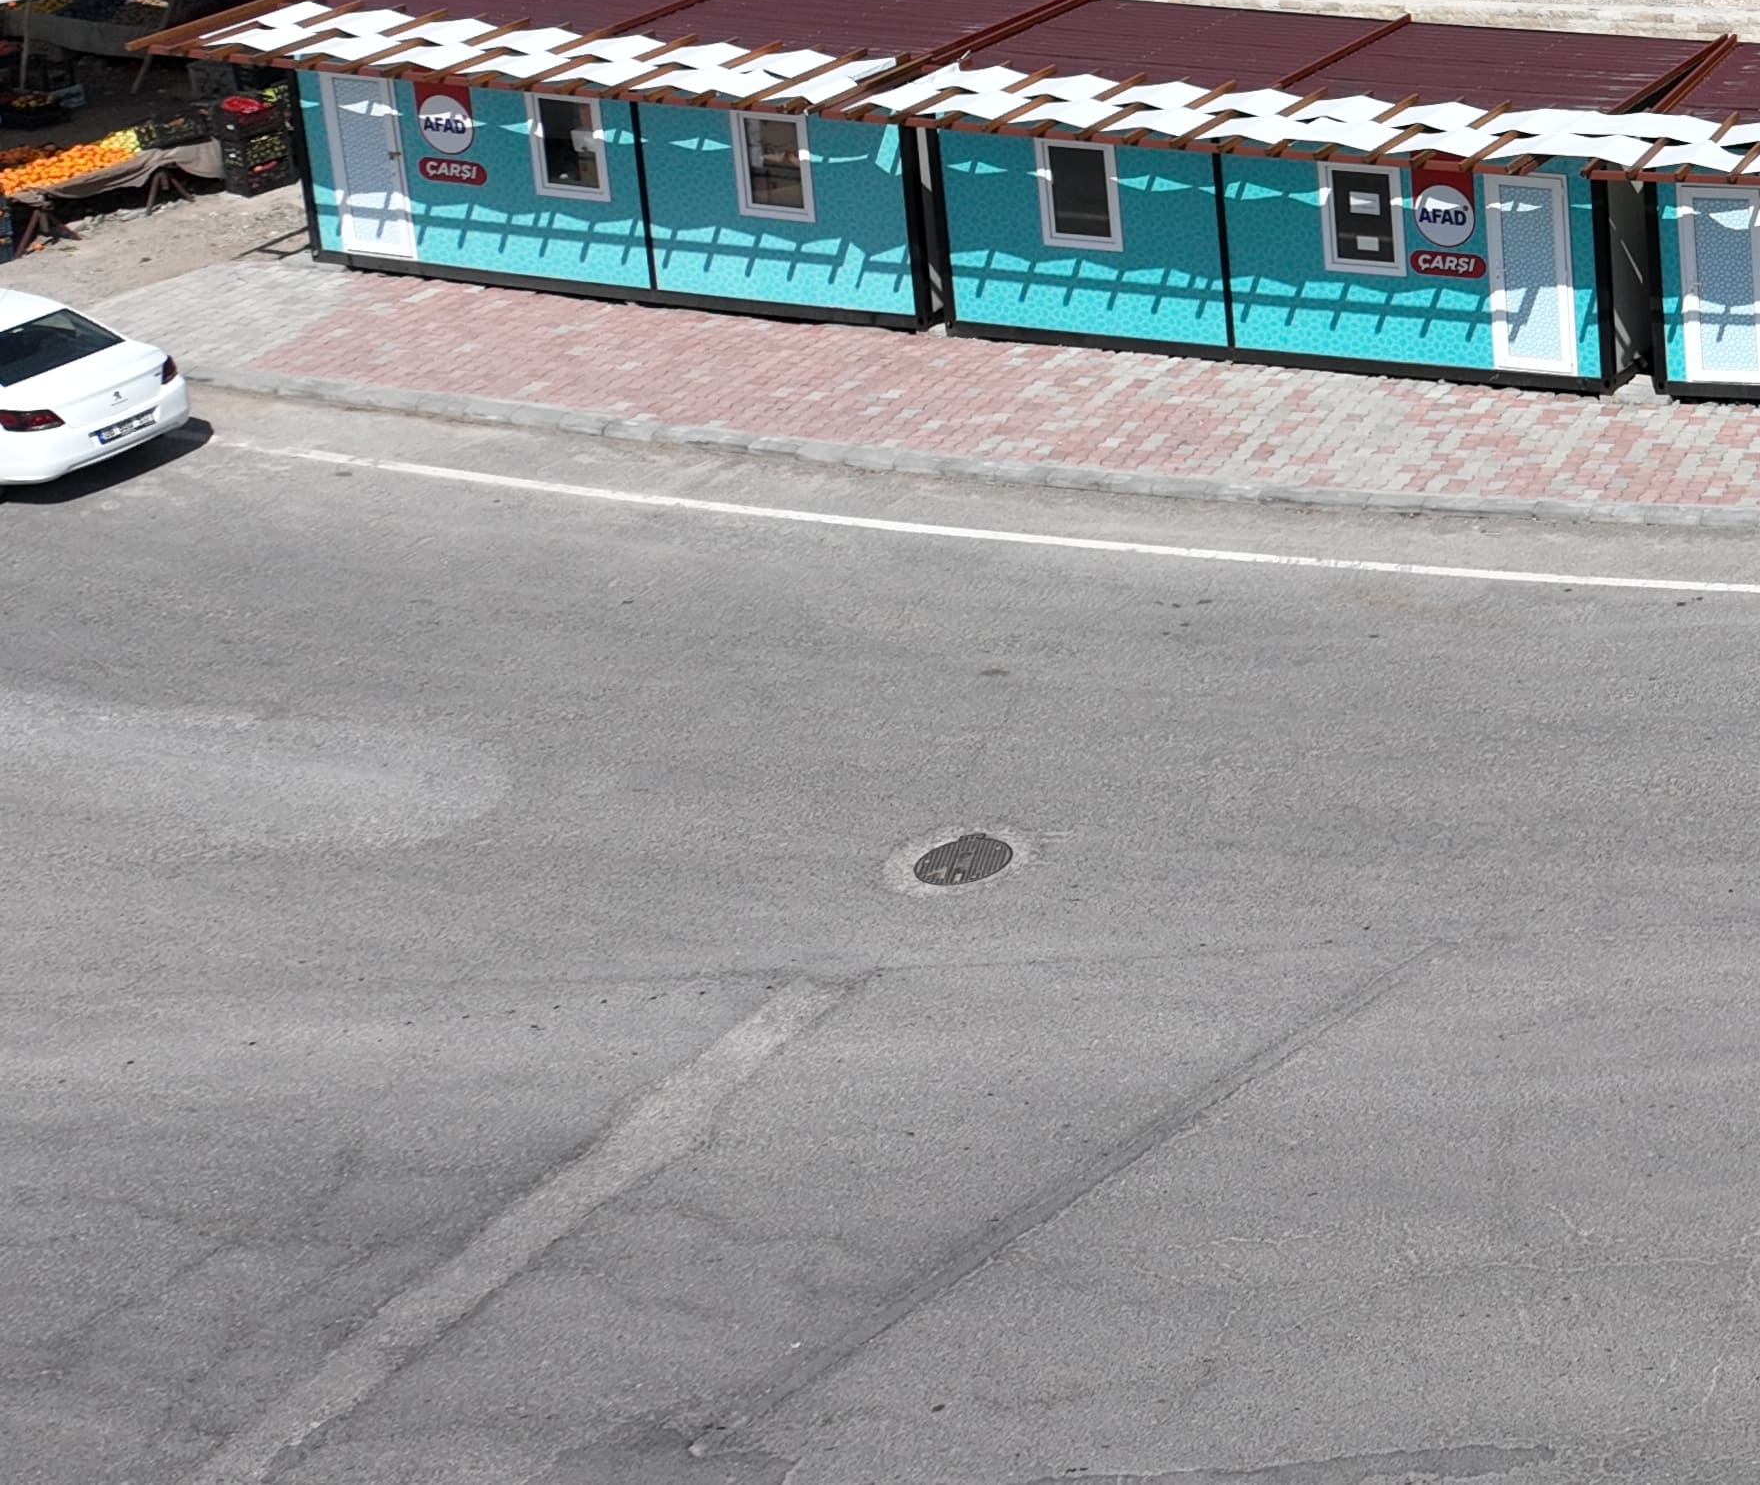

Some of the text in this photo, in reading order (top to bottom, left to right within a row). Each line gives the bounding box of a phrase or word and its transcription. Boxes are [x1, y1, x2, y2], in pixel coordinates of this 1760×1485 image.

[424, 116, 466, 134] AFAD
[425, 161, 478, 180] ÇARŞI
[1418, 207, 1467, 226] AFAD
[1418, 254, 1476, 274] ÇARŞI
